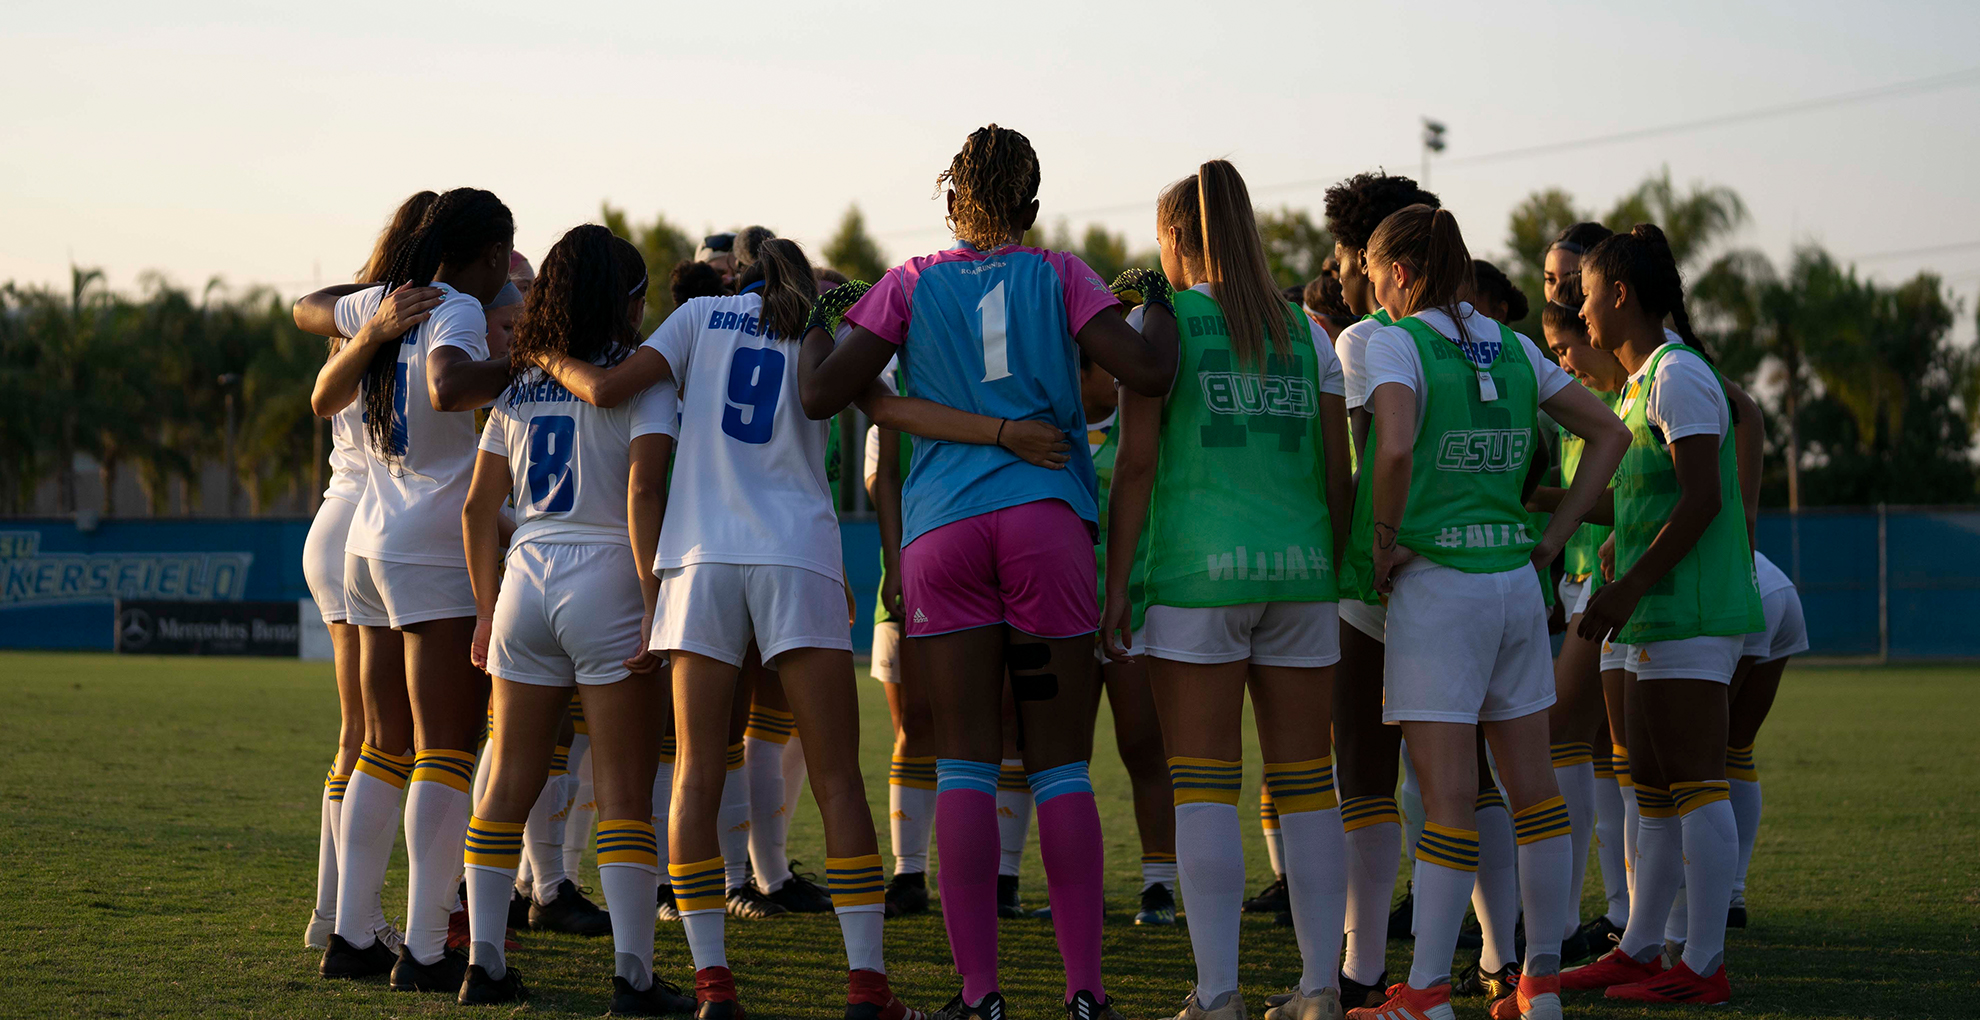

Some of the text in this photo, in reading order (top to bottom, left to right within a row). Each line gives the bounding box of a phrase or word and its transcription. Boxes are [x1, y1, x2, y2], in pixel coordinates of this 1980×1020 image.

[961, 262, 1007, 276] ROARUNNRS
[976, 279, 1013, 383] 1
[721, 347, 786, 444] 9
[528, 415, 575, 512] 8
[1436, 428, 1531, 472] CSUB
